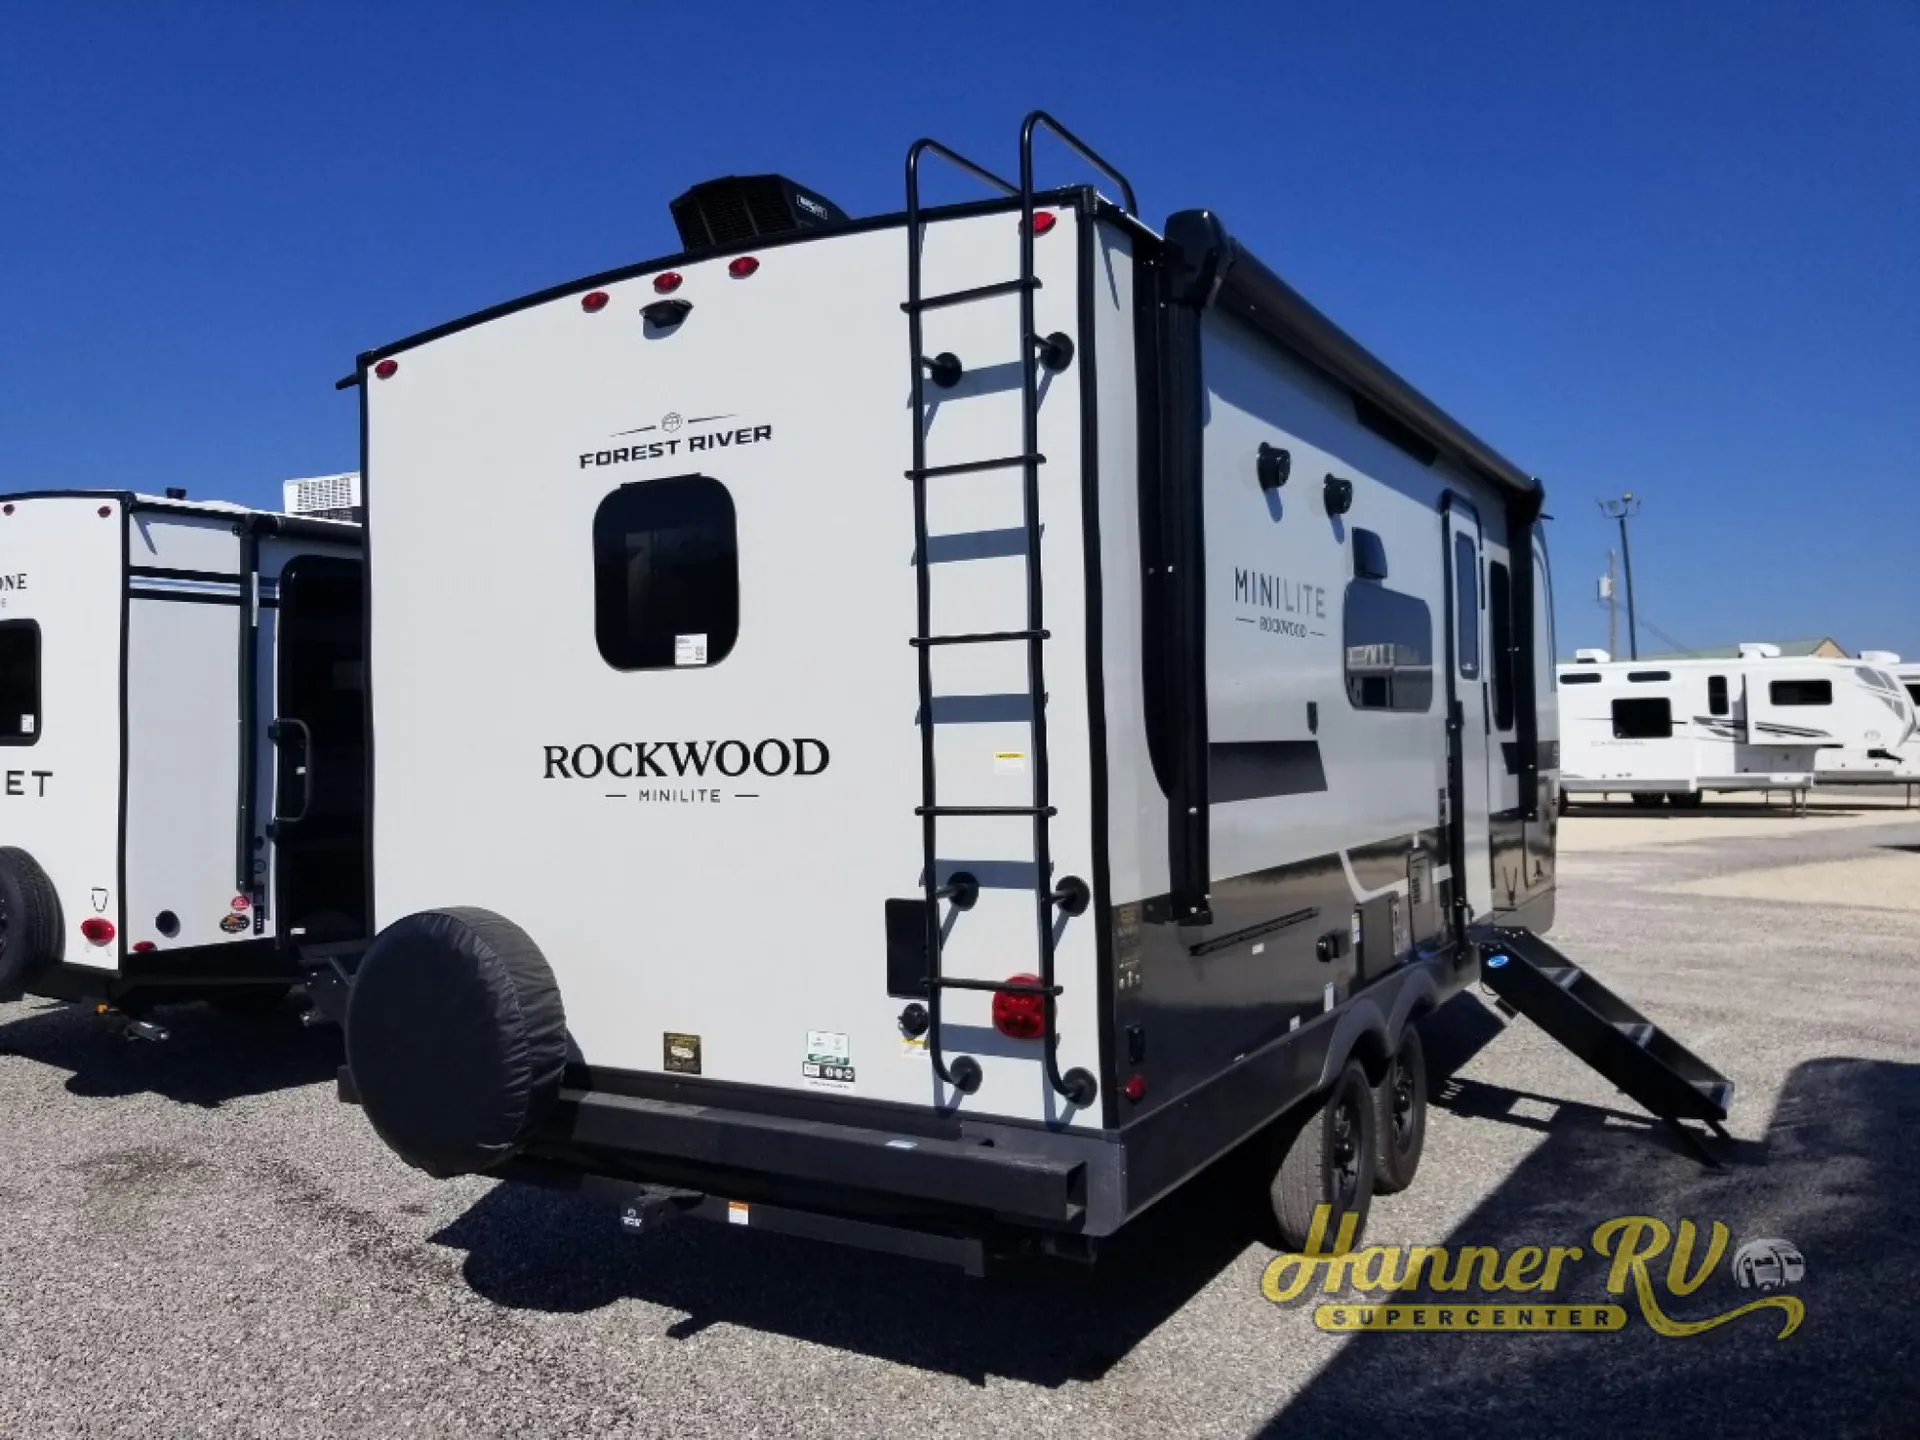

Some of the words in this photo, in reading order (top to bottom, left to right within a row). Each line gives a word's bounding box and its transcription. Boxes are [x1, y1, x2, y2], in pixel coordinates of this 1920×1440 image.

[579, 438, 681, 469] FOREST
[688, 425, 772, 452] RIVER
[1234, 566, 1326, 619] MINILITE
[543, 738, 830, 779] ROCKWOOD
[638, 788, 721, 803] MINILITE
